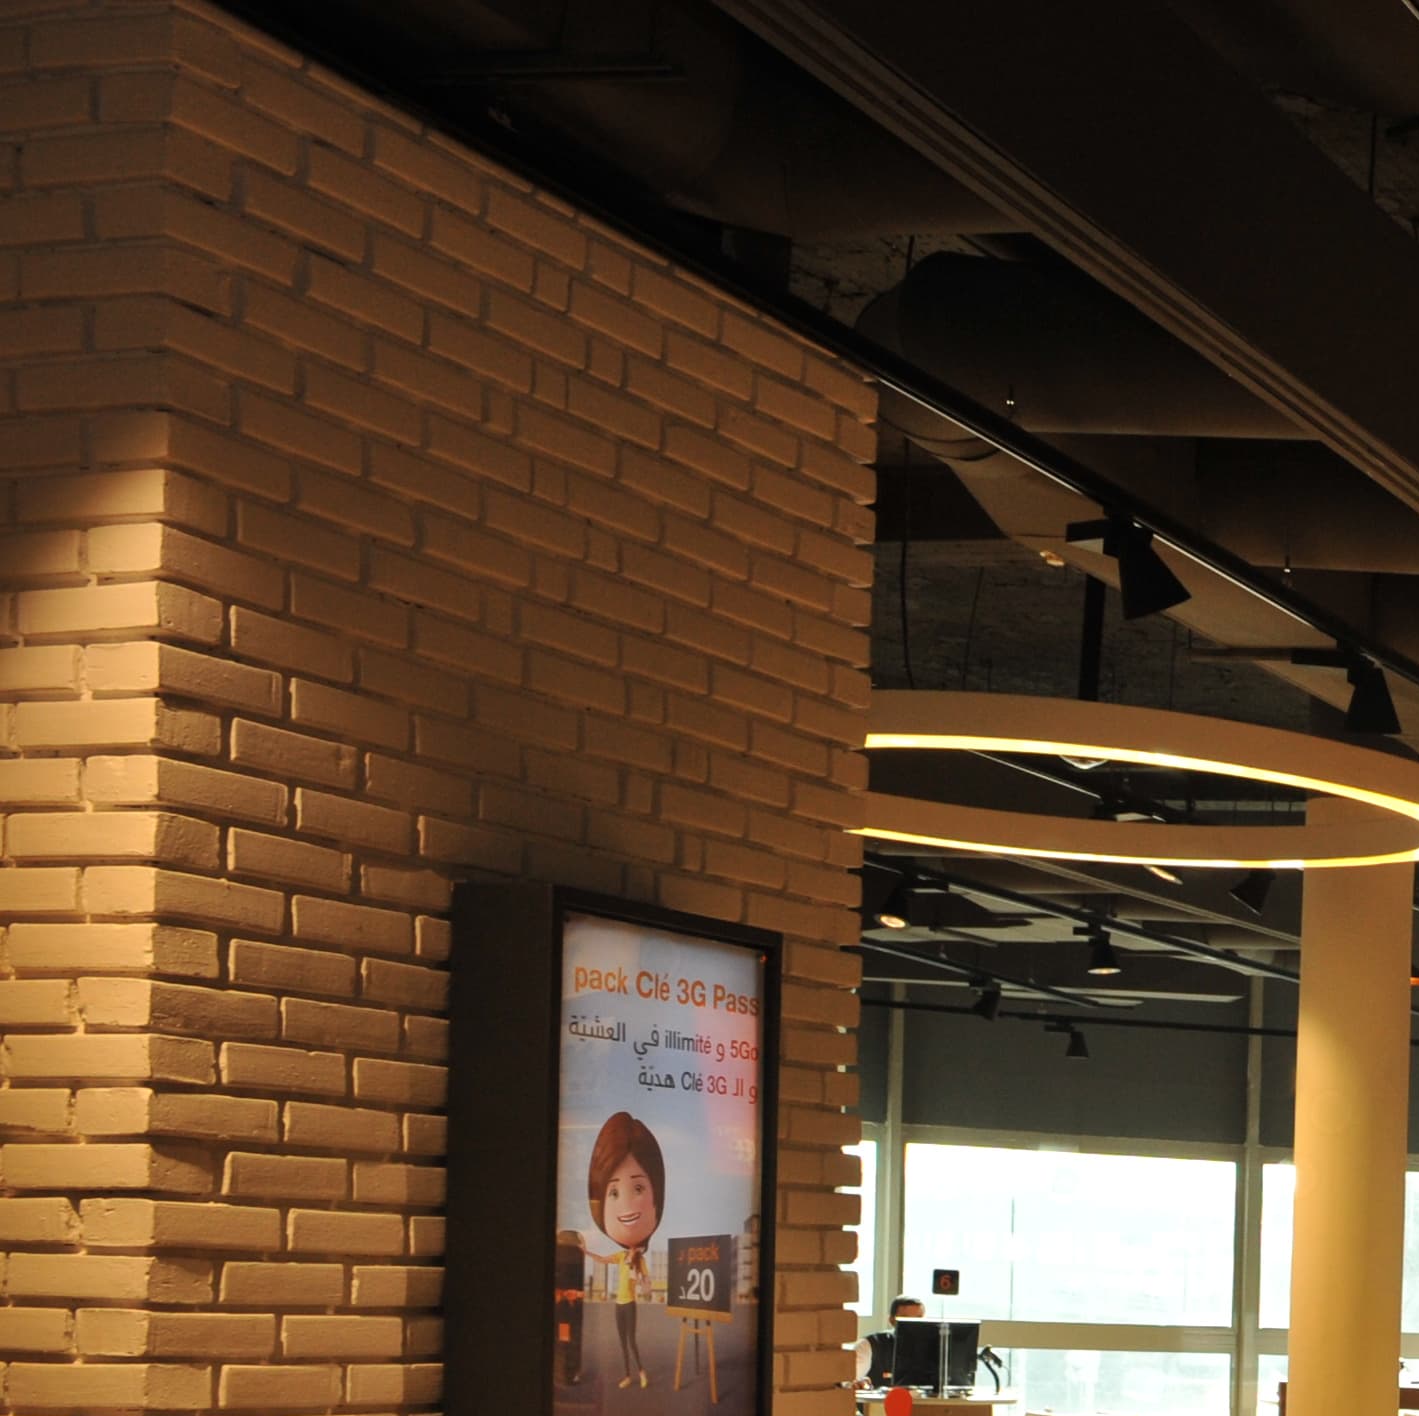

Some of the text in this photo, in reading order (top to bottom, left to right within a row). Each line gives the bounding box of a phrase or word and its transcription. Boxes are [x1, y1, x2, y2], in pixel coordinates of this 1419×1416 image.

[575, 966, 760, 1017] pack Clé 3G Pass
[633, 1024, 660, 1061] في
[664, 1029, 712, 1055] illimité
[715, 1043, 725, 1063] و
[730, 1040, 759, 1061] 5Go
[681, 1071, 704, 1092] Clé
[707, 1076, 727, 1096] 3G
[687, 1242, 720, 1264] pack
[940, 1274, 951, 1290] 6
